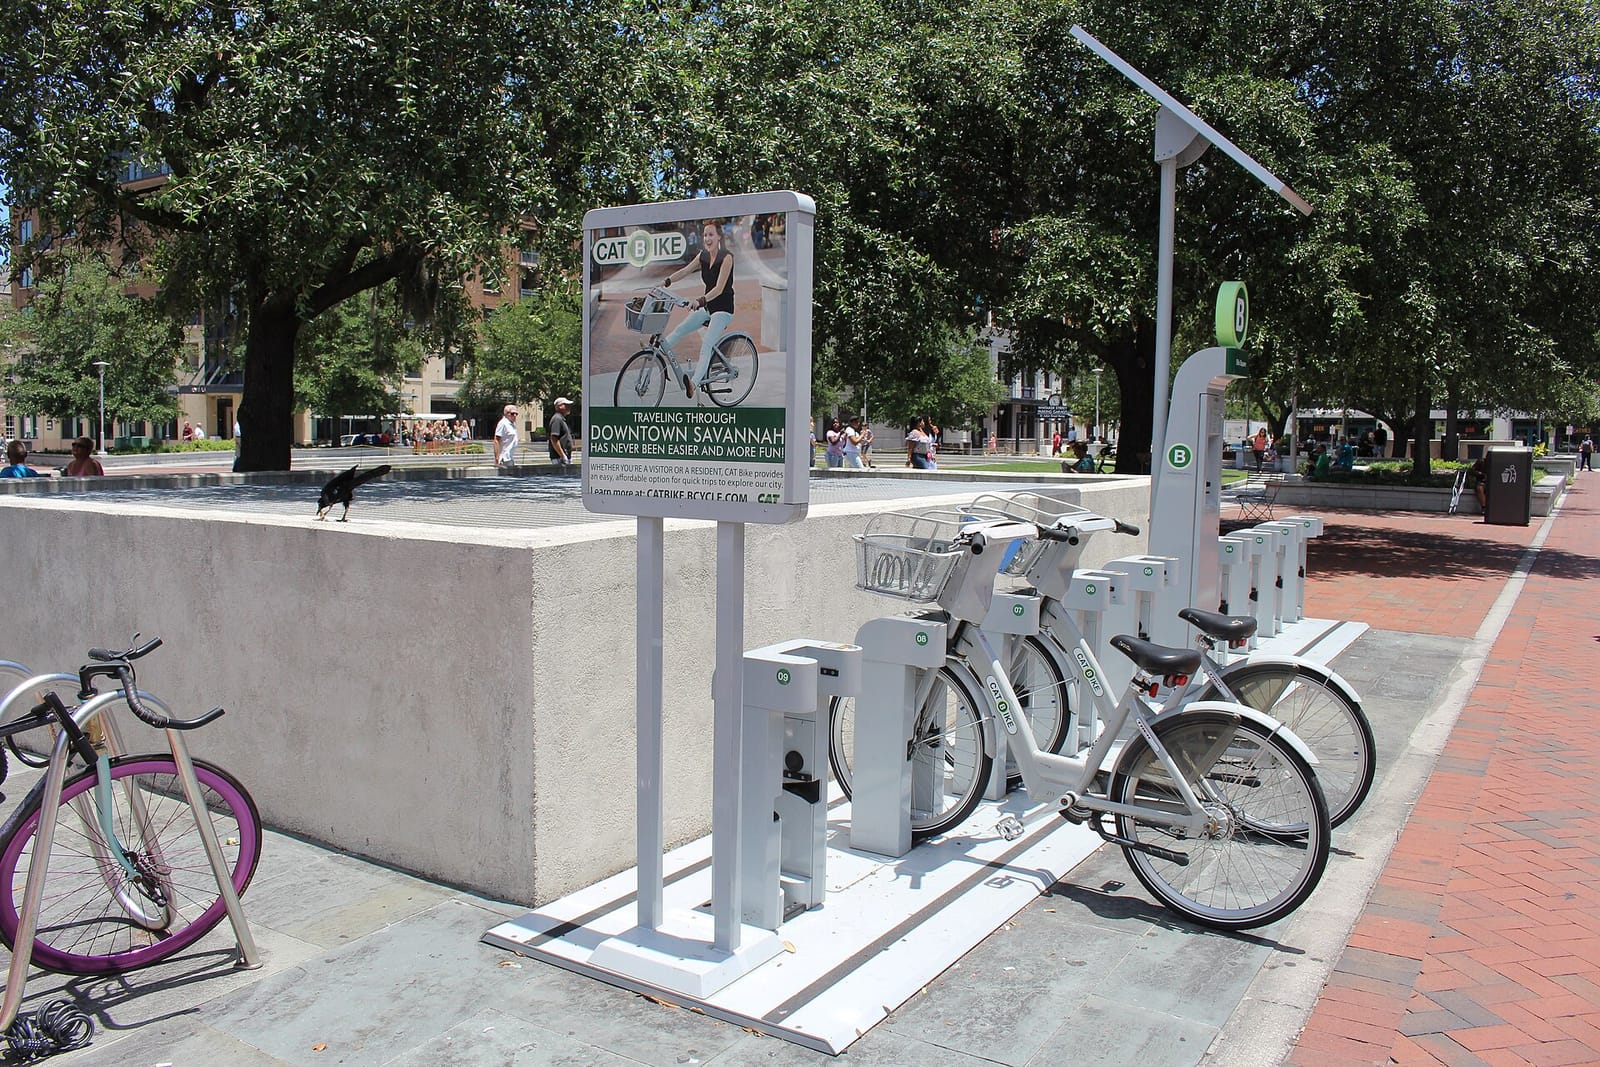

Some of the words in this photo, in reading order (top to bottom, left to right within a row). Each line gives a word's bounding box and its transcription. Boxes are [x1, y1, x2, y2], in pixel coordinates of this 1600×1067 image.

[596, 241, 627, 260] CAT
[1236, 297, 1245, 333] B
[632, 412, 683, 423] TRAVELING
[686, 412, 736, 424] THROUGH
[591, 424, 688, 442] DOWNTOWN
[693, 425, 785, 445] SAVANNAH
[590, 442, 609, 453] HAS
[610, 443, 640, 454] NEVER
[642, 443, 665, 455] BEEN
[668, 444, 699, 456] EASIER
[701, 445, 724, 456] AND
[726, 446, 756, 457] MORE
[759, 447, 785, 459] FUN!
[1174, 449, 1186, 464] B
[590, 463, 620, 472] WHETHER
[620, 464, 642, 473] YOU'RE
[643, 465, 649, 473] A
[649, 465, 673, 474] VISITOR
[673, 466, 684, 474] OR
[684, 466, 690, 474] A
[690, 466, 724, 477] RESIDENT,
[724, 468, 738, 477] CAT
[738, 468, 753, 477] Bike
[754, 470, 784, 479] provides
[599, 475, 614, 483] easy,
[615, 473, 647, 483] affordable
[648, 475, 670, 485] option
[671, 476, 681, 484] for
[681, 477, 701, 486] quick
[701, 478, 717, 487] trips
[727, 479, 754, 489] explore
[768, 480, 784, 490] city.
[590, 486, 612, 496] Learn
[613, 489, 633, 497] more
[757, 493, 780, 504] CAT
[1014, 606, 1022, 614] 07
[917, 635, 927, 643] 08
[1076, 653, 1090, 668] CAT
[777, 671, 789, 682] 09
[990, 682, 1003, 700] CAT
